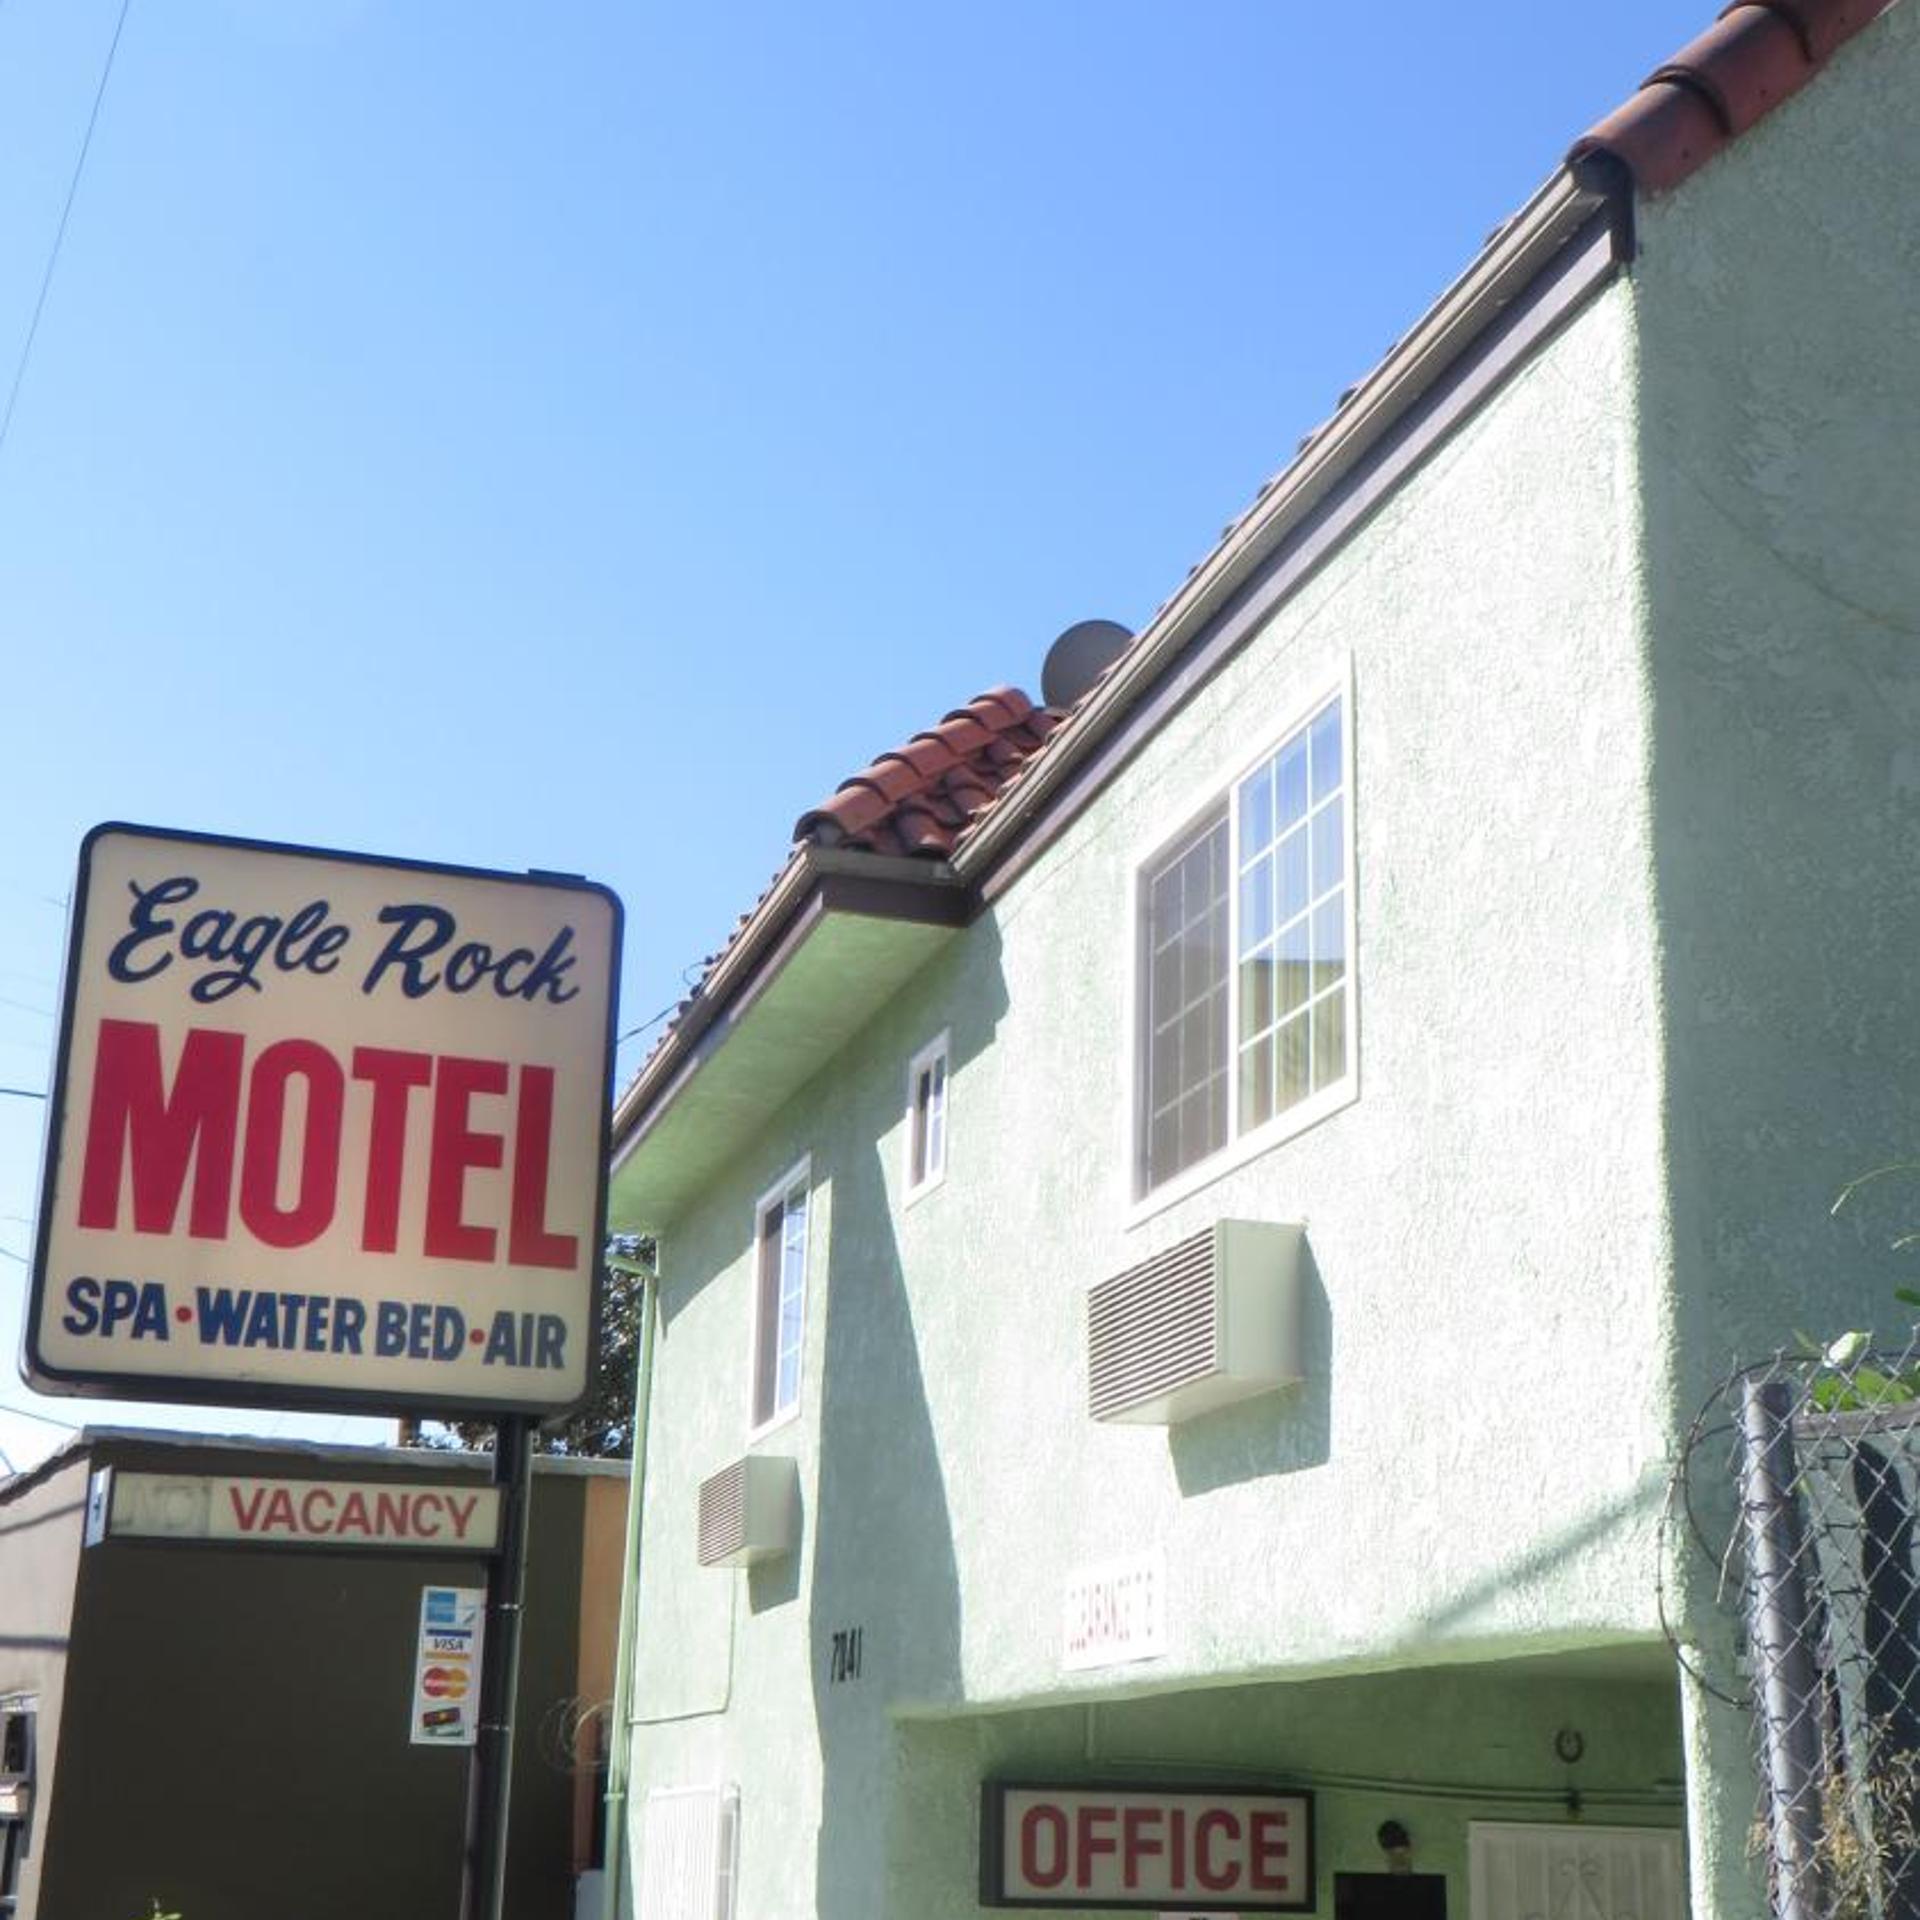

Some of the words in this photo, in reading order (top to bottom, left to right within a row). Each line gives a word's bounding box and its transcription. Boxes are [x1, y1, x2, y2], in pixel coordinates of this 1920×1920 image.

[107, 877, 350, 1003] Eagle
[361, 904, 580, 1005] Rock
[77, 1018, 578, 1270] MOTEL
[62, 1276, 169, 1341] SPA
[196, 1286, 367, 1356] WATER
[375, 1300, 466, 1362] BED
[482, 1310, 568, 1371] AIR
[229, 1486, 478, 1538] VACANCY
[433, 1638, 464, 1651] VISA
[1020, 1804, 1289, 1891] OFFICE
